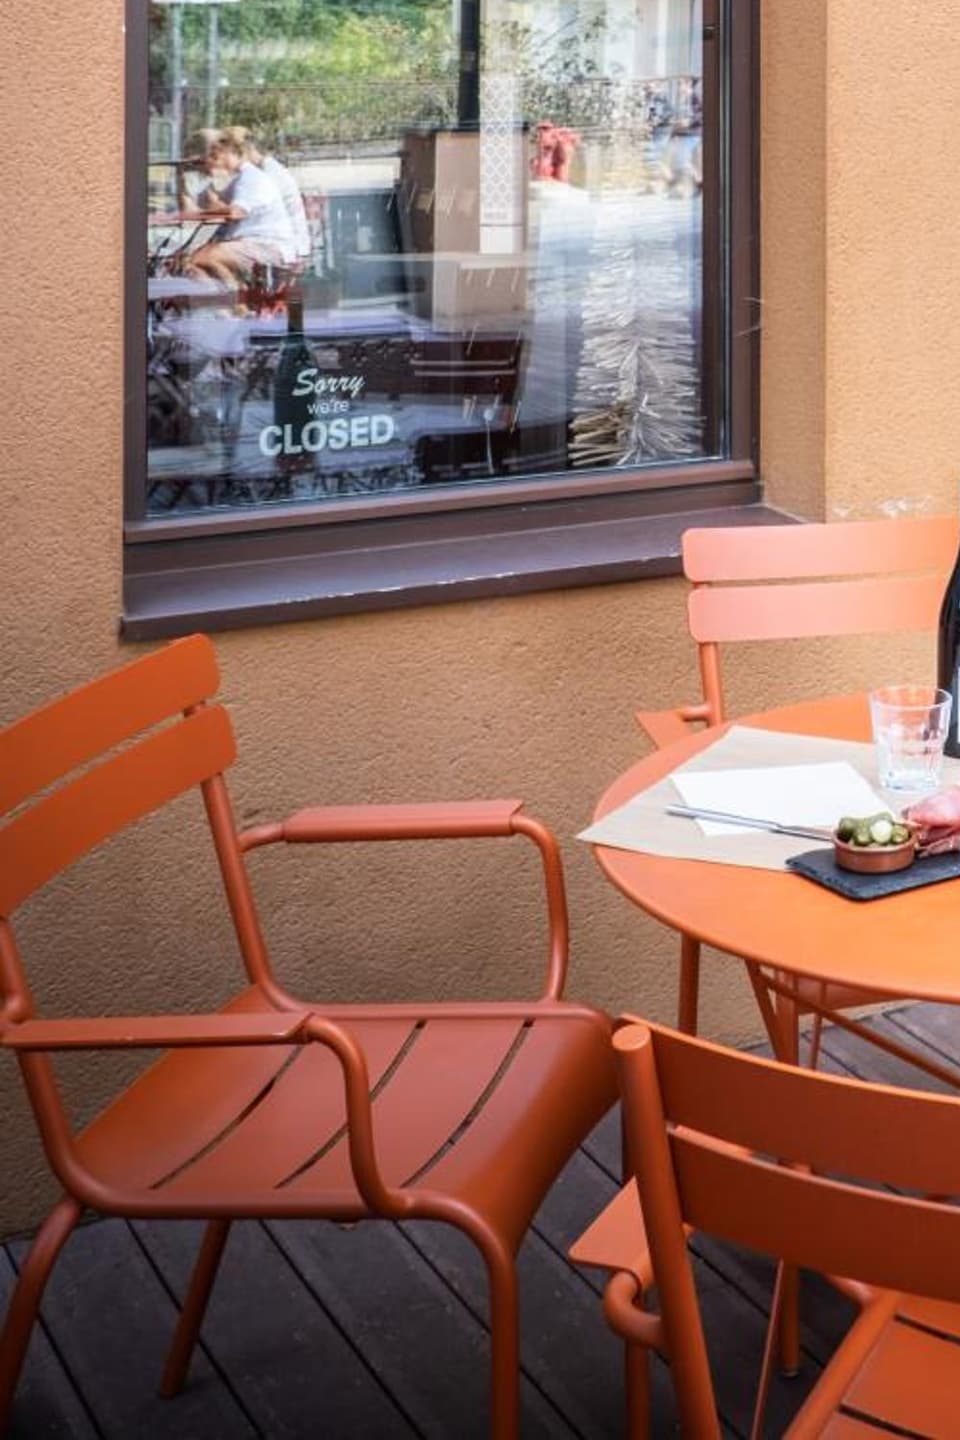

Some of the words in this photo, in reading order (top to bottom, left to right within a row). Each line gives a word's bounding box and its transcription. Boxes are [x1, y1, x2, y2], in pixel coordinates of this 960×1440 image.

[291, 367, 365, 398] Sorry
[307, 398, 349, 414] we're
[259, 414, 395, 456] CLOSED
